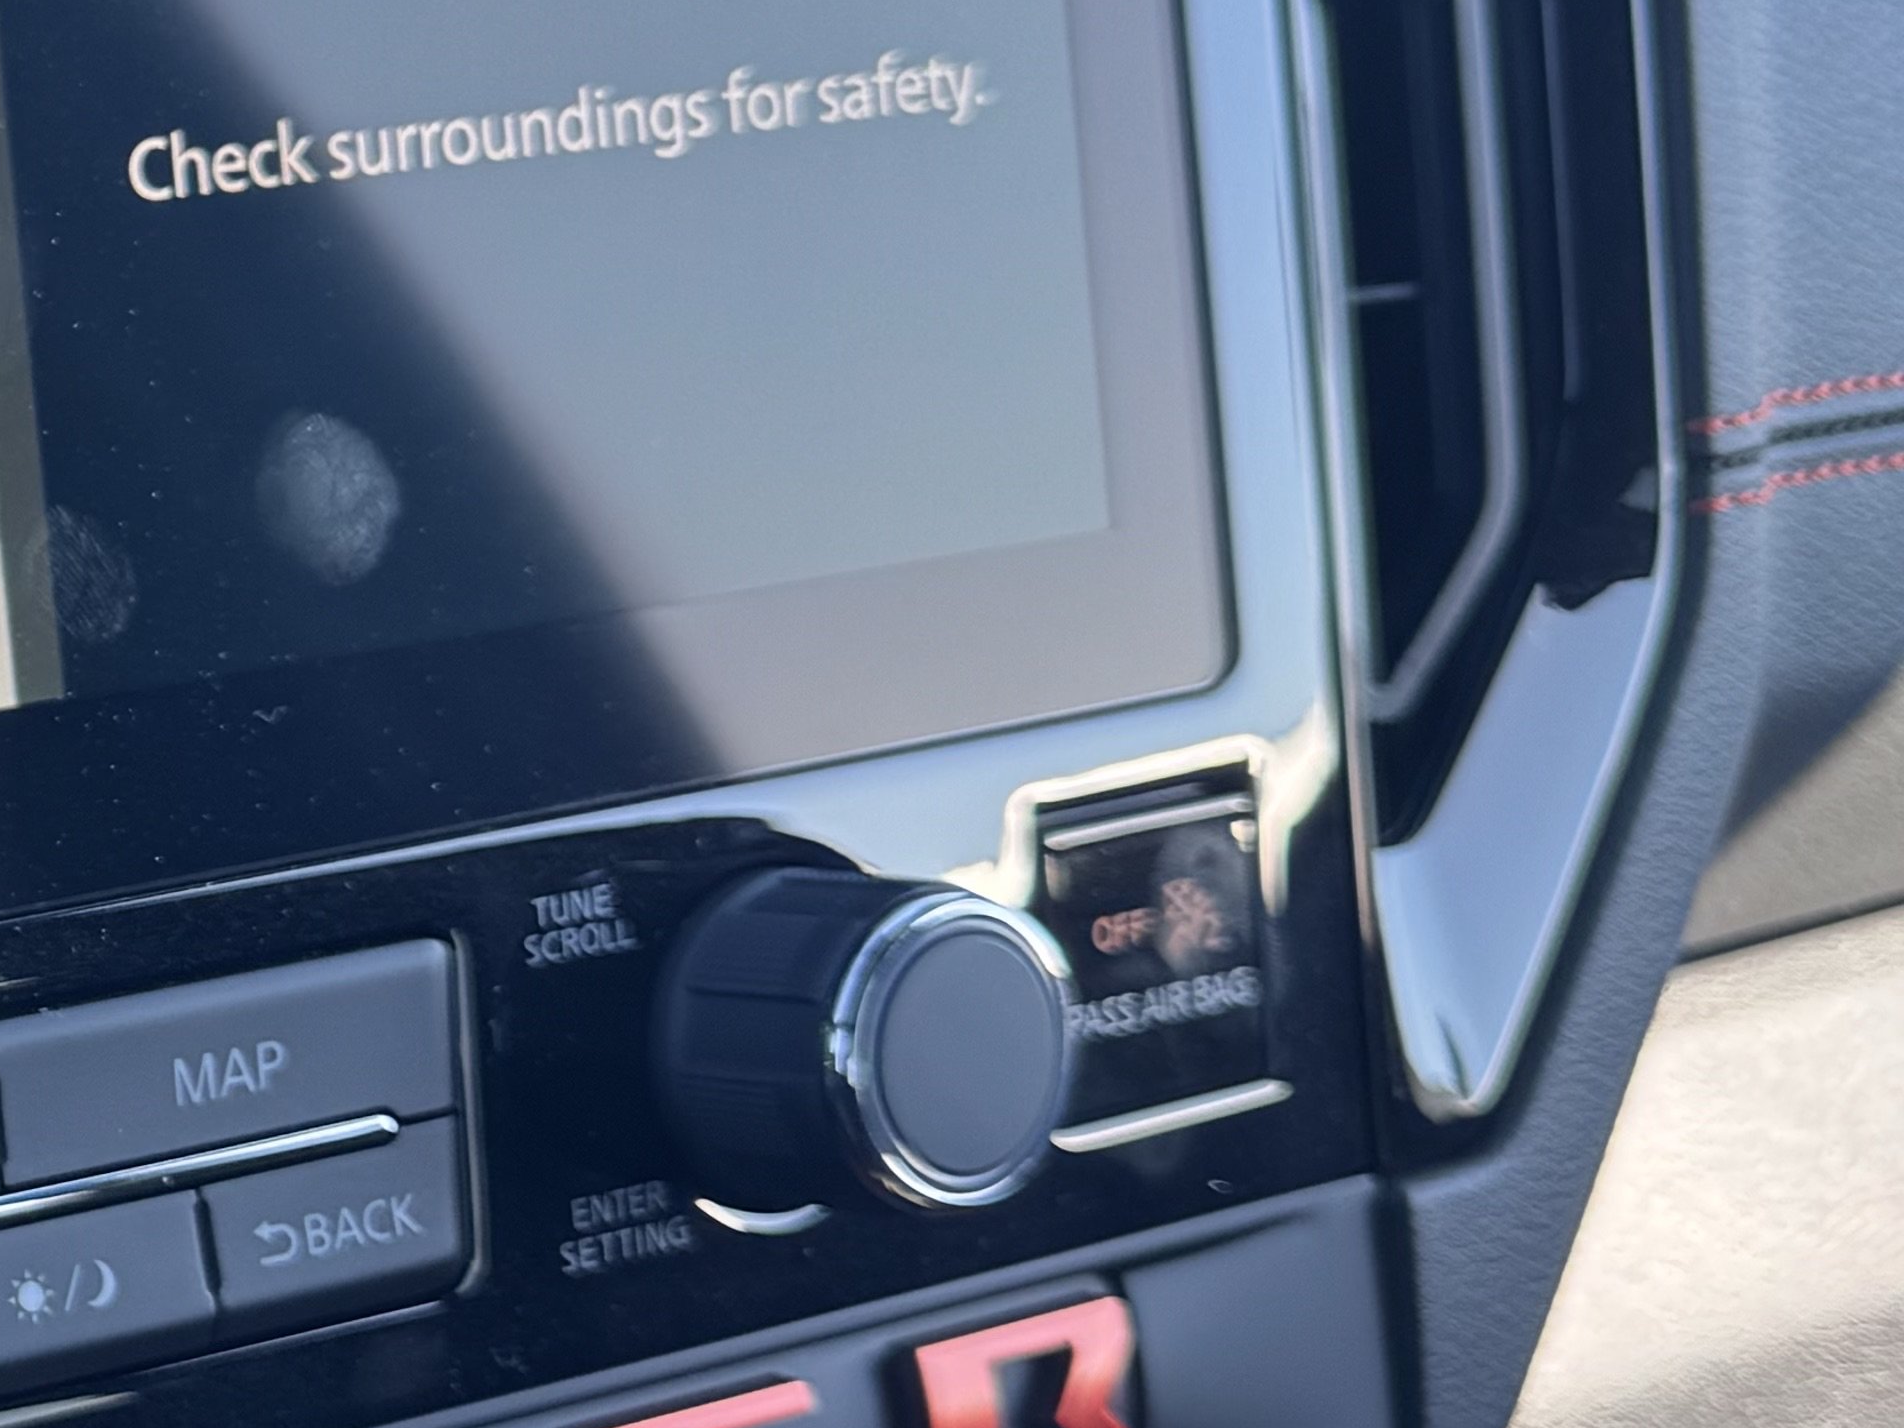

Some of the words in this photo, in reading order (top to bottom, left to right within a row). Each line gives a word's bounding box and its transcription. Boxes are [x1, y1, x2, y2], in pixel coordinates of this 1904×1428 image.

[129, 118, 316, 203] Check
[328, 86, 713, 181] surroundings
[720, 65, 805, 135] for
[816, 48, 991, 126] safety.
[530, 882, 617, 929] TUNE
[523, 918, 641, 968] SCROLL
[172, 1039, 288, 1108] MAP
[303, 1192, 425, 1258] BACK
[569, 1179, 671, 1234] ENTER
[559, 1214, 695, 1279] SETTING
